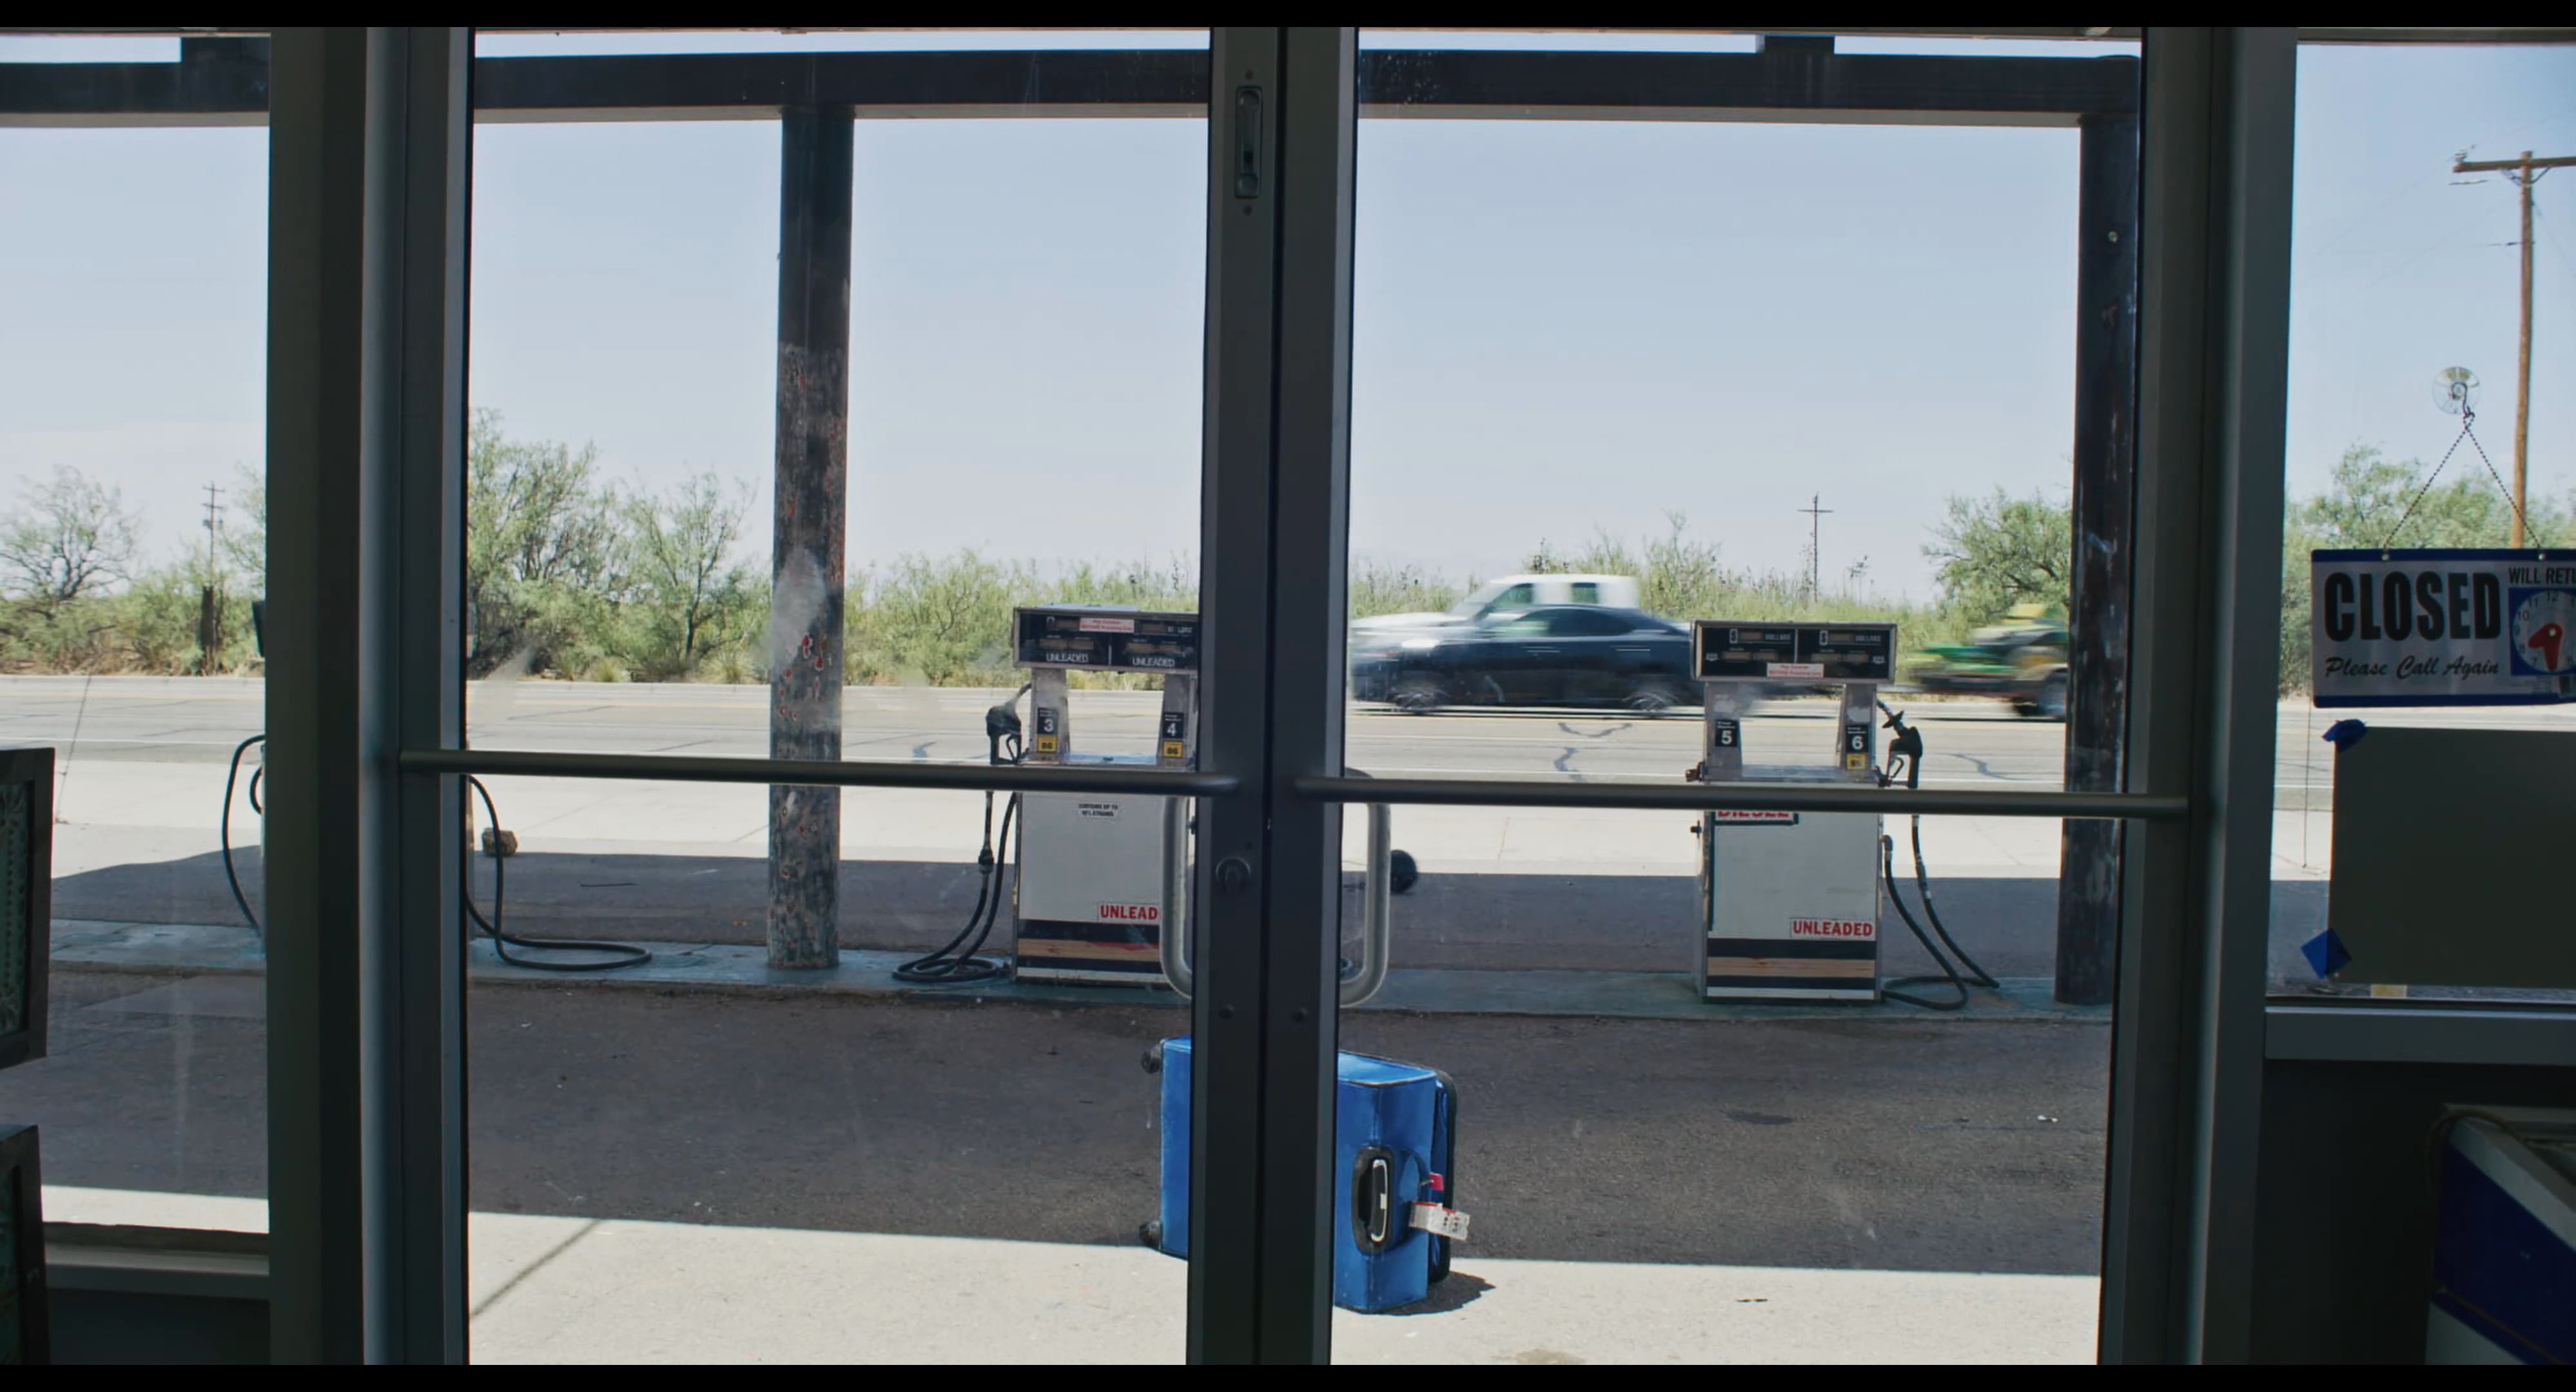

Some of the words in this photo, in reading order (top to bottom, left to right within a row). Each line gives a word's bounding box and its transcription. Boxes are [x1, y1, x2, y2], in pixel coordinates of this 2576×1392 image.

[2508, 567, 2541, 585] WILL
[2324, 571, 2501, 641] CLOSED
[1046, 653, 1088, 662] UNLEADED
[1132, 657, 1175, 667] UNLEADED
[2325, 657, 2387, 678] Please
[2396, 655, 2439, 680] Call
[2441, 655, 2500, 681] Again
[1044, 719, 1053, 732] 3
[1167, 722, 1176, 737] 4
[1721, 730, 1732, 744] 5
[1852, 735, 1863, 749] 6
[1100, 904, 1159, 920] UNLEAD
[1793, 920, 1873, 936] UNLEADED
